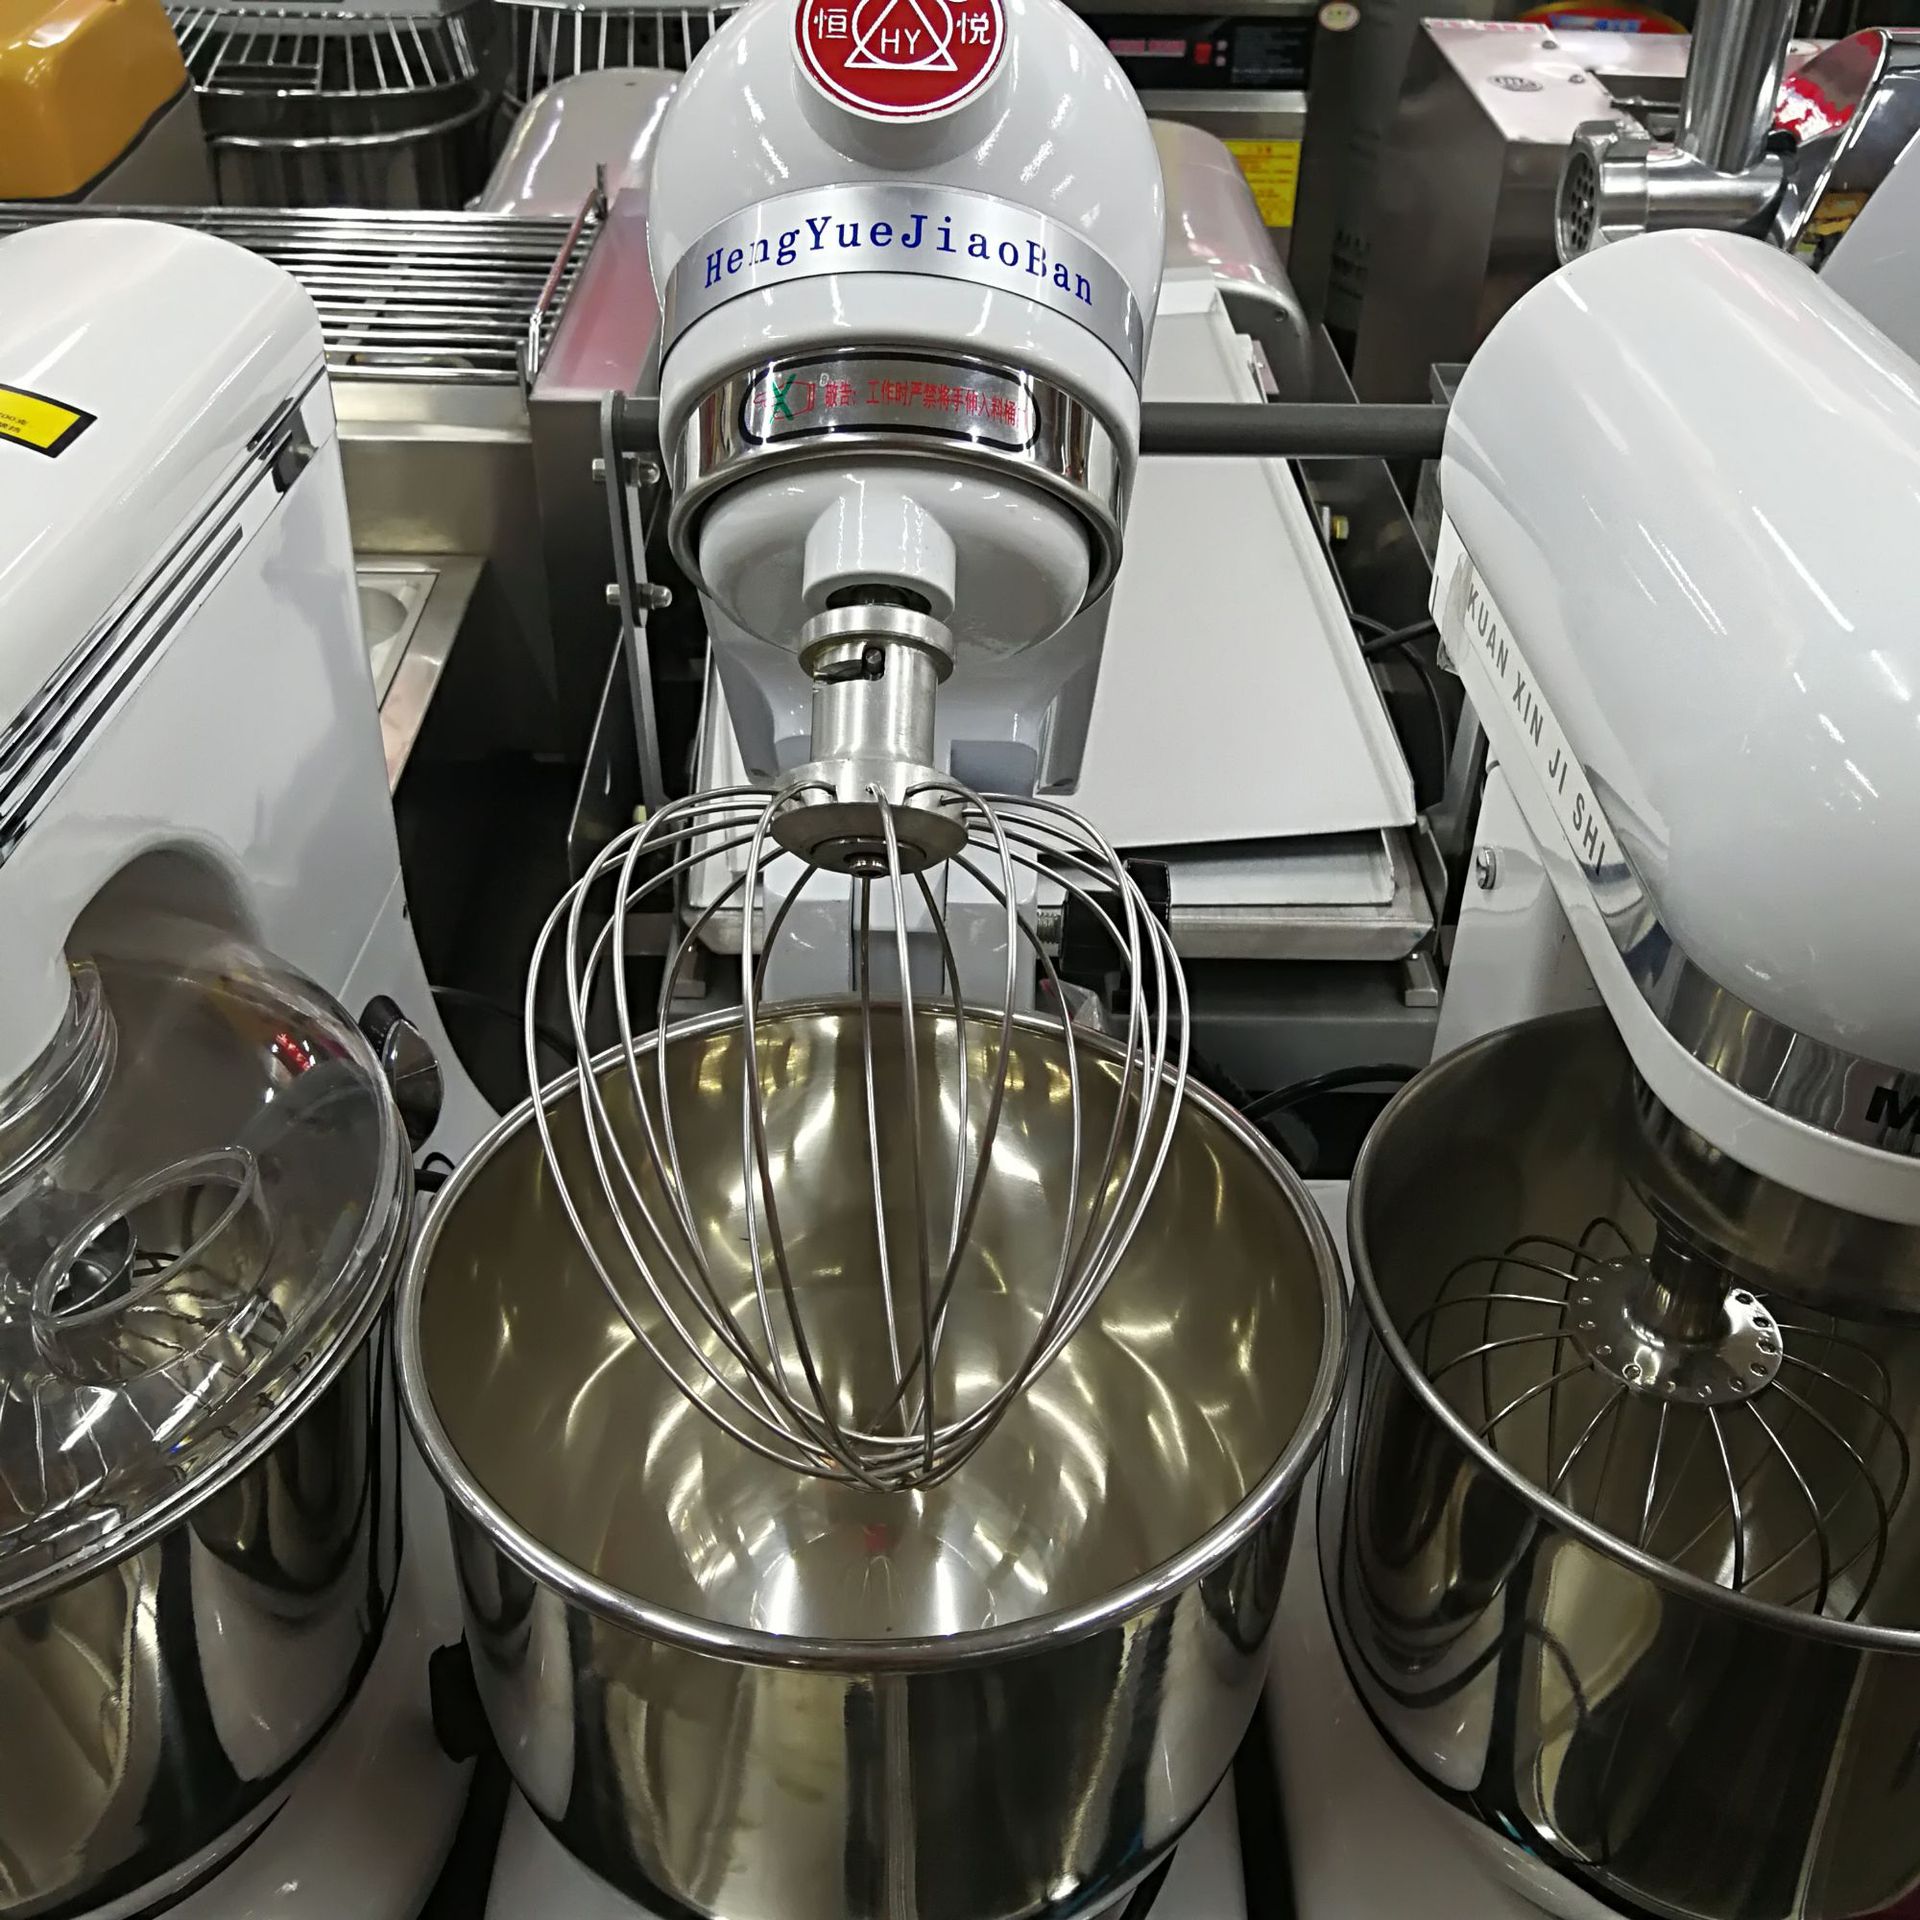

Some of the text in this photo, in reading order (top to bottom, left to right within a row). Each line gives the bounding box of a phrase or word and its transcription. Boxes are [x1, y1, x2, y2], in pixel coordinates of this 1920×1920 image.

[814, 8, 847, 39] 恒
[956, 12, 990, 44] 悦
[880, 28, 921, 54] HY
[704, 214, 1092, 305] HengYueJiaoBan
[1512, 670, 1544, 747] XIN
[1549, 748, 1568, 795] JI
[1573, 793, 1606, 876] SHI
